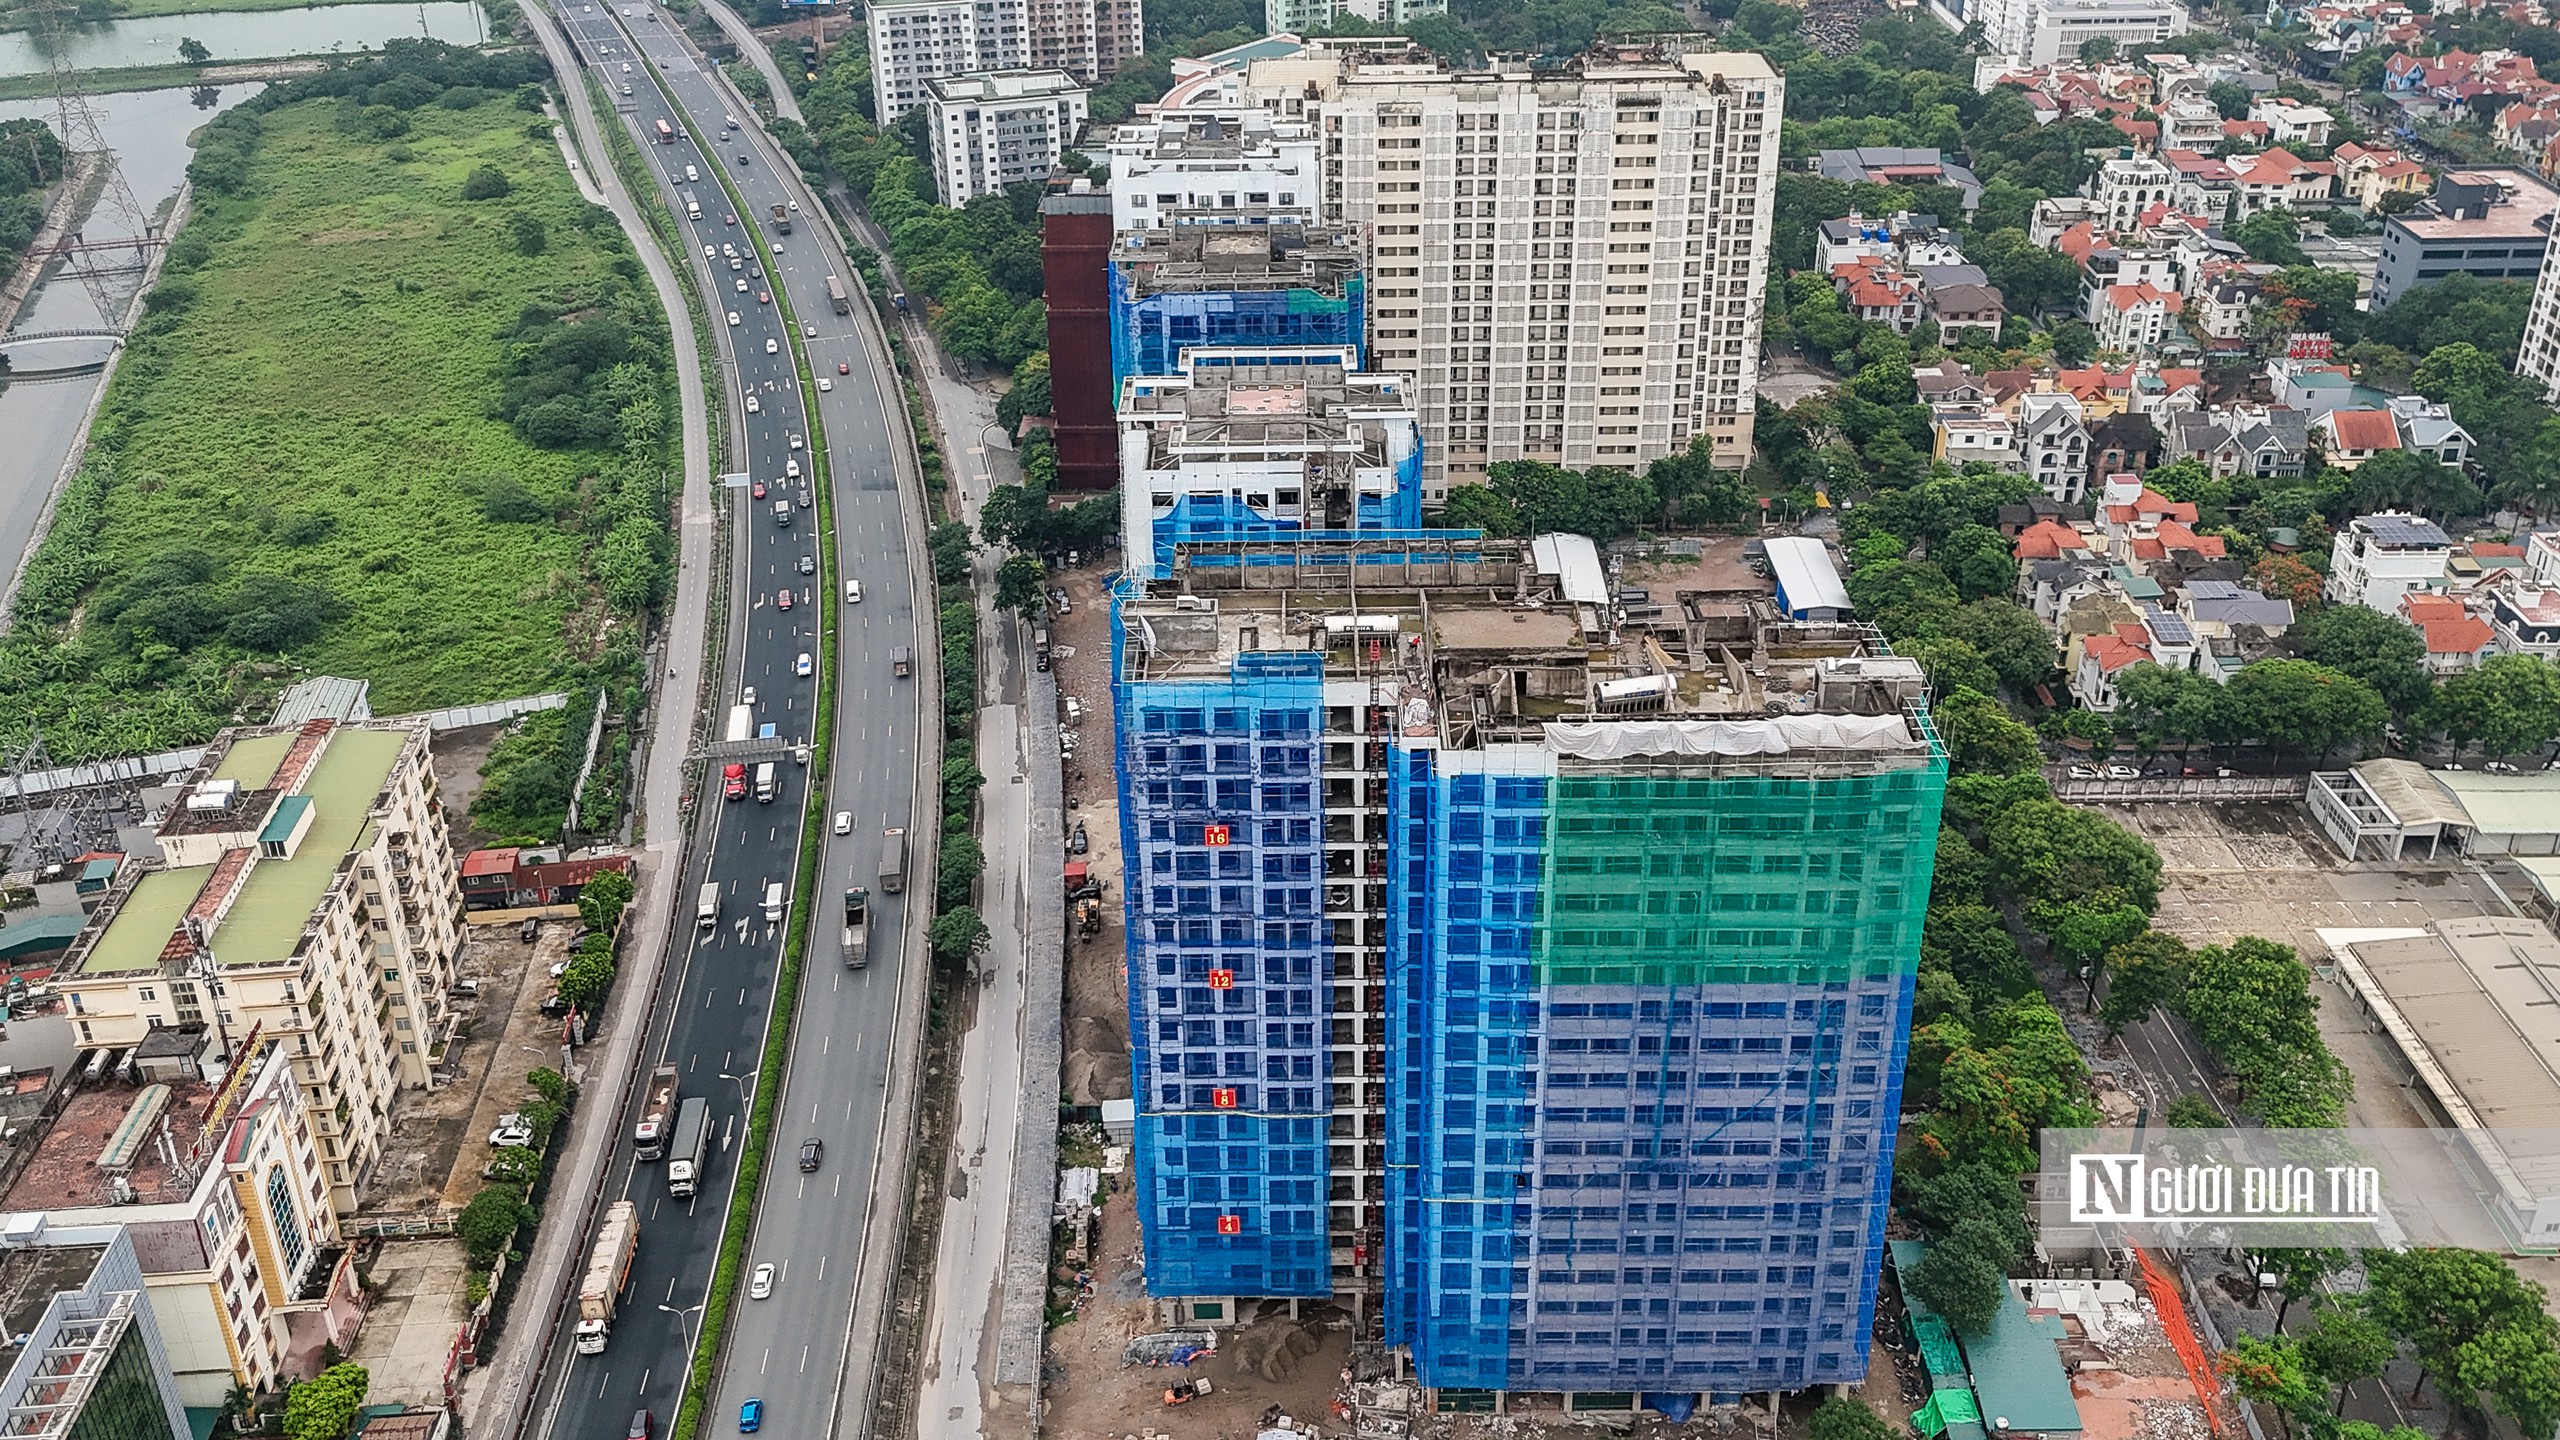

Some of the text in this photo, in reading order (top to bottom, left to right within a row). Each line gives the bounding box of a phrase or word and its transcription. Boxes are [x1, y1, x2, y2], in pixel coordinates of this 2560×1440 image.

[1209, 833, 1225, 844] 16
[1213, 976, 1229, 987] 12
[1221, 1095, 1229, 1105] 8
[1224, 1222, 1233, 1232] 4
